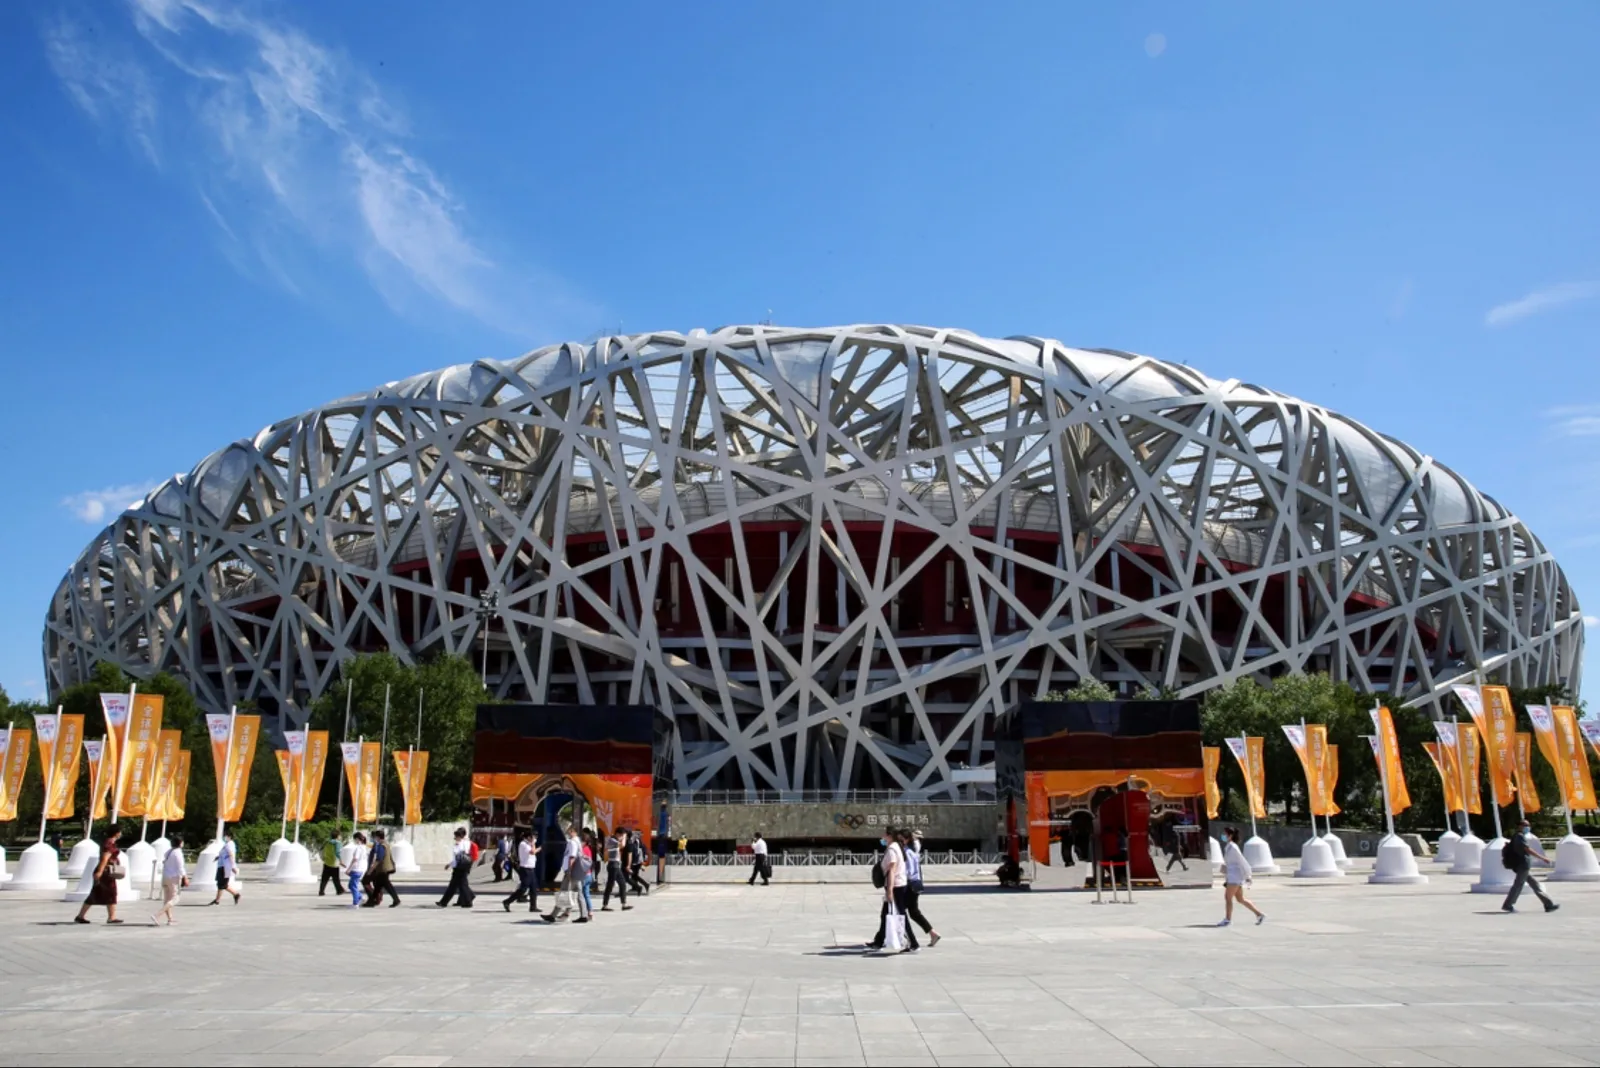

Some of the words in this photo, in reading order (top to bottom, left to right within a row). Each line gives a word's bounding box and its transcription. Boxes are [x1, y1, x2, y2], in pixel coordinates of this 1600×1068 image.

[867, 814, 929, 825] 国家体育场
